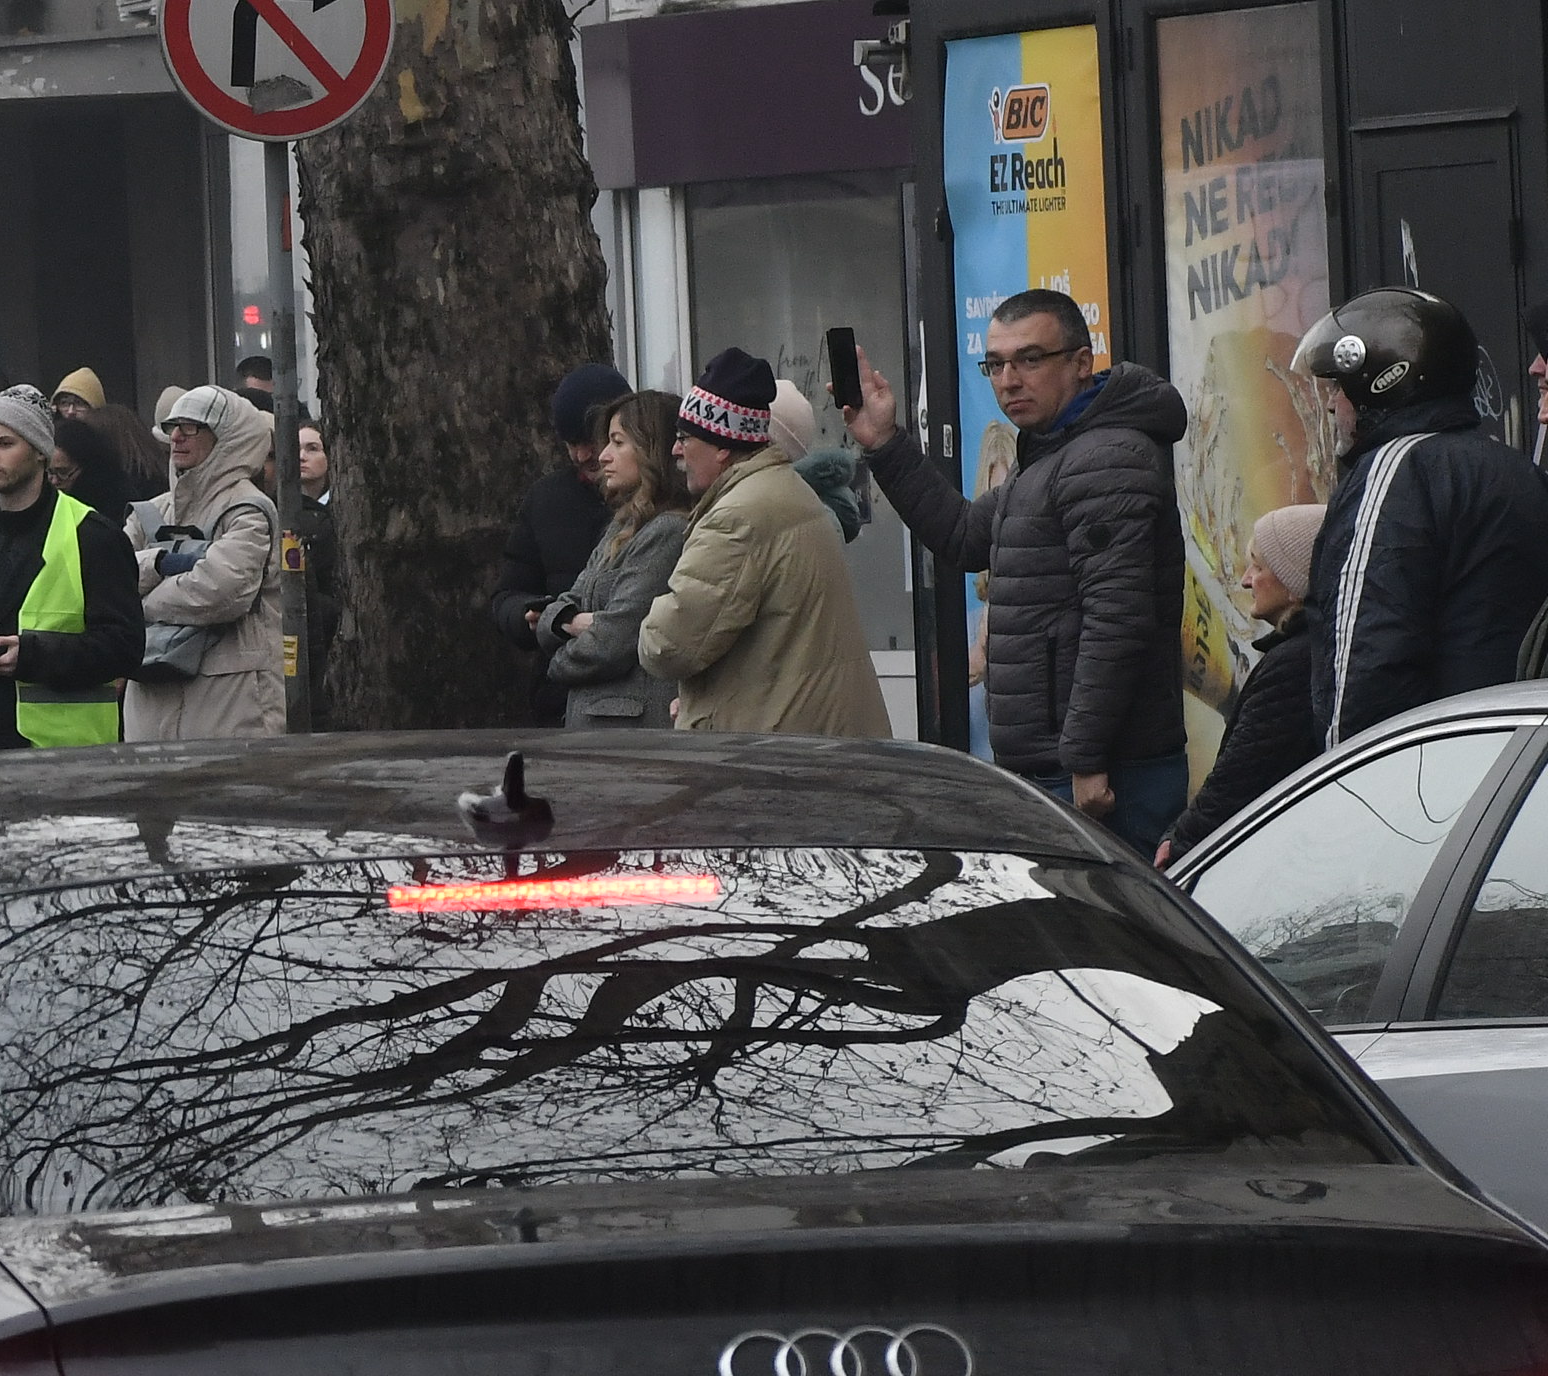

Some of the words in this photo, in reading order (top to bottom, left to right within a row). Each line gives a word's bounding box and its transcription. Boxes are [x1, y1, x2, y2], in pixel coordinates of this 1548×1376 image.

[1005, 94, 1048, 130] BIC
[1180, 75, 1282, 174] NIKAD
[990, 153, 1007, 193] EZ
[1011, 136, 1066, 192] Reach
[1039, 193, 1067, 212] LIGHTER
[1183, 176, 1230, 248] NE
